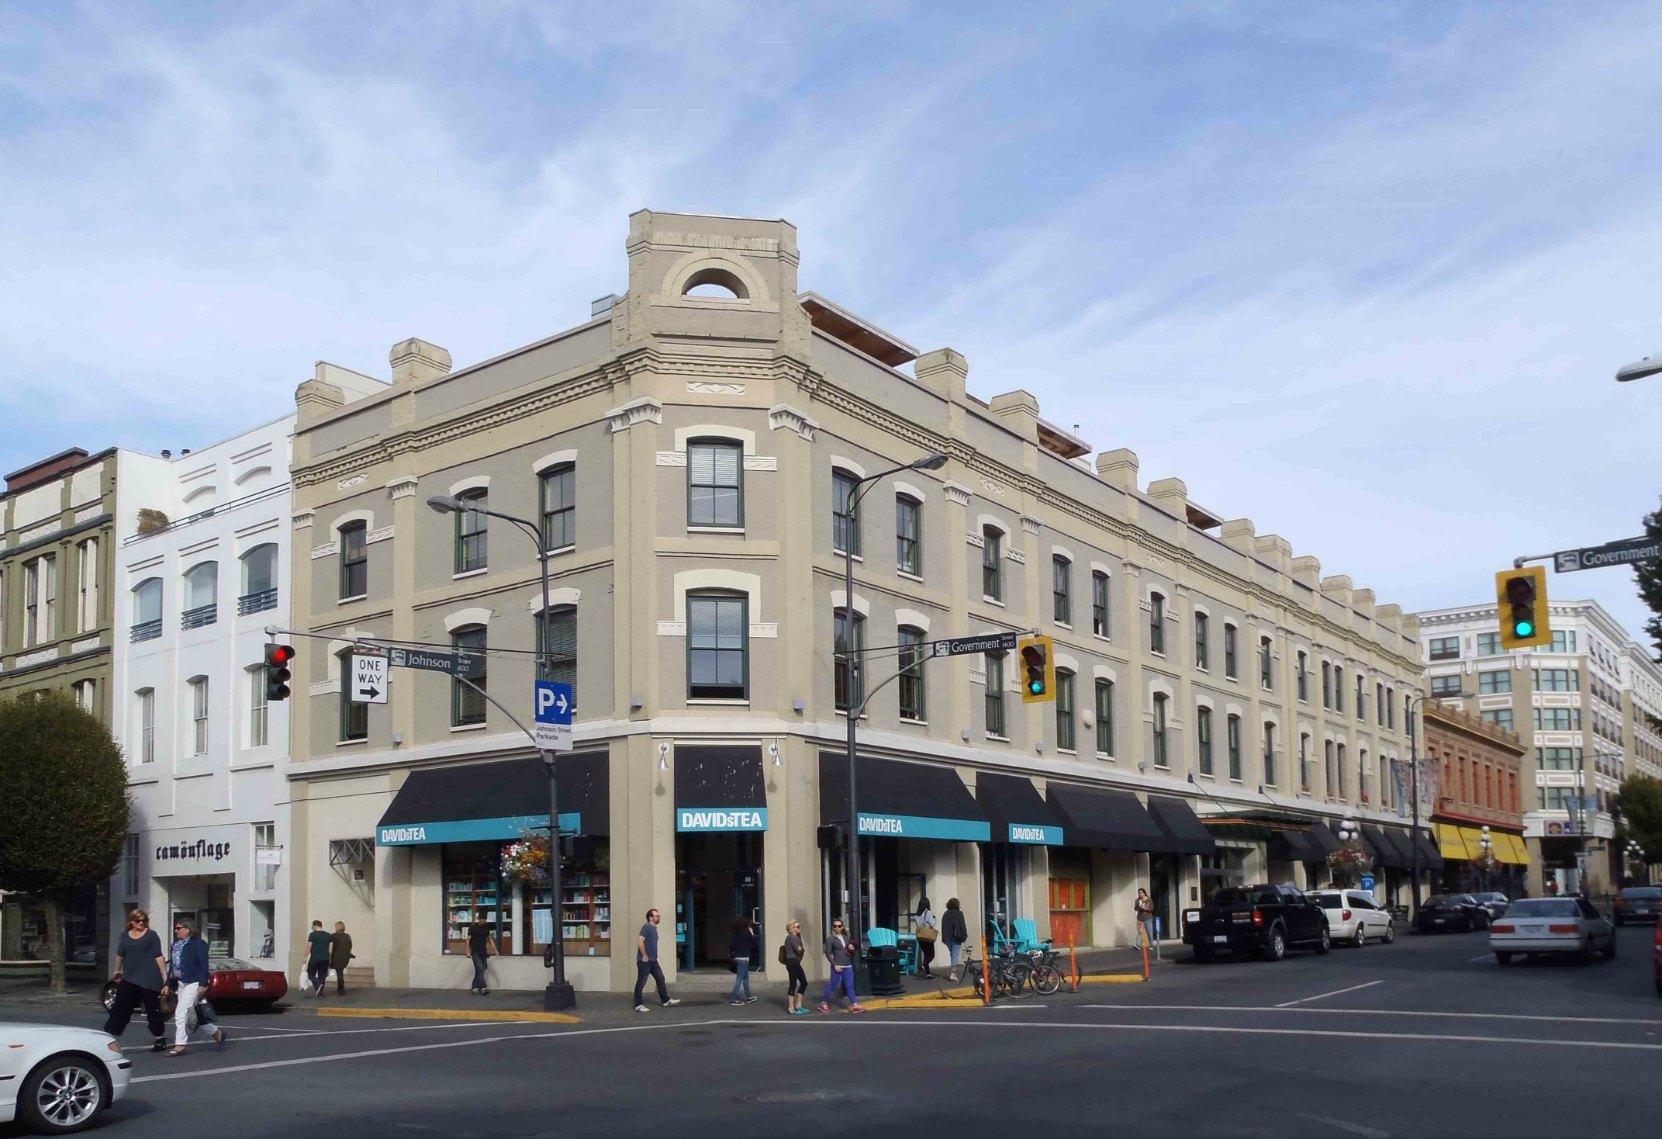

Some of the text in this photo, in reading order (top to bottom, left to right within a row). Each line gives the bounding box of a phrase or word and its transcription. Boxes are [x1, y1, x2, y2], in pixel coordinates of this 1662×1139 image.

[1582, 545, 1660, 565] Government
[951, 639, 1000, 653] Government
[360, 659, 381, 671] ONE
[408, 653, 451, 669] Johnson
[358, 673, 382, 684] WAY
[538, 687, 555, 715] P
[681, 812, 763, 828] DAVIDsTEA
[859, 817, 903, 833] DAVIDsTEA
[381, 827, 426, 843] DAVIDsTEA
[155, 839, 231, 862] camönflage
